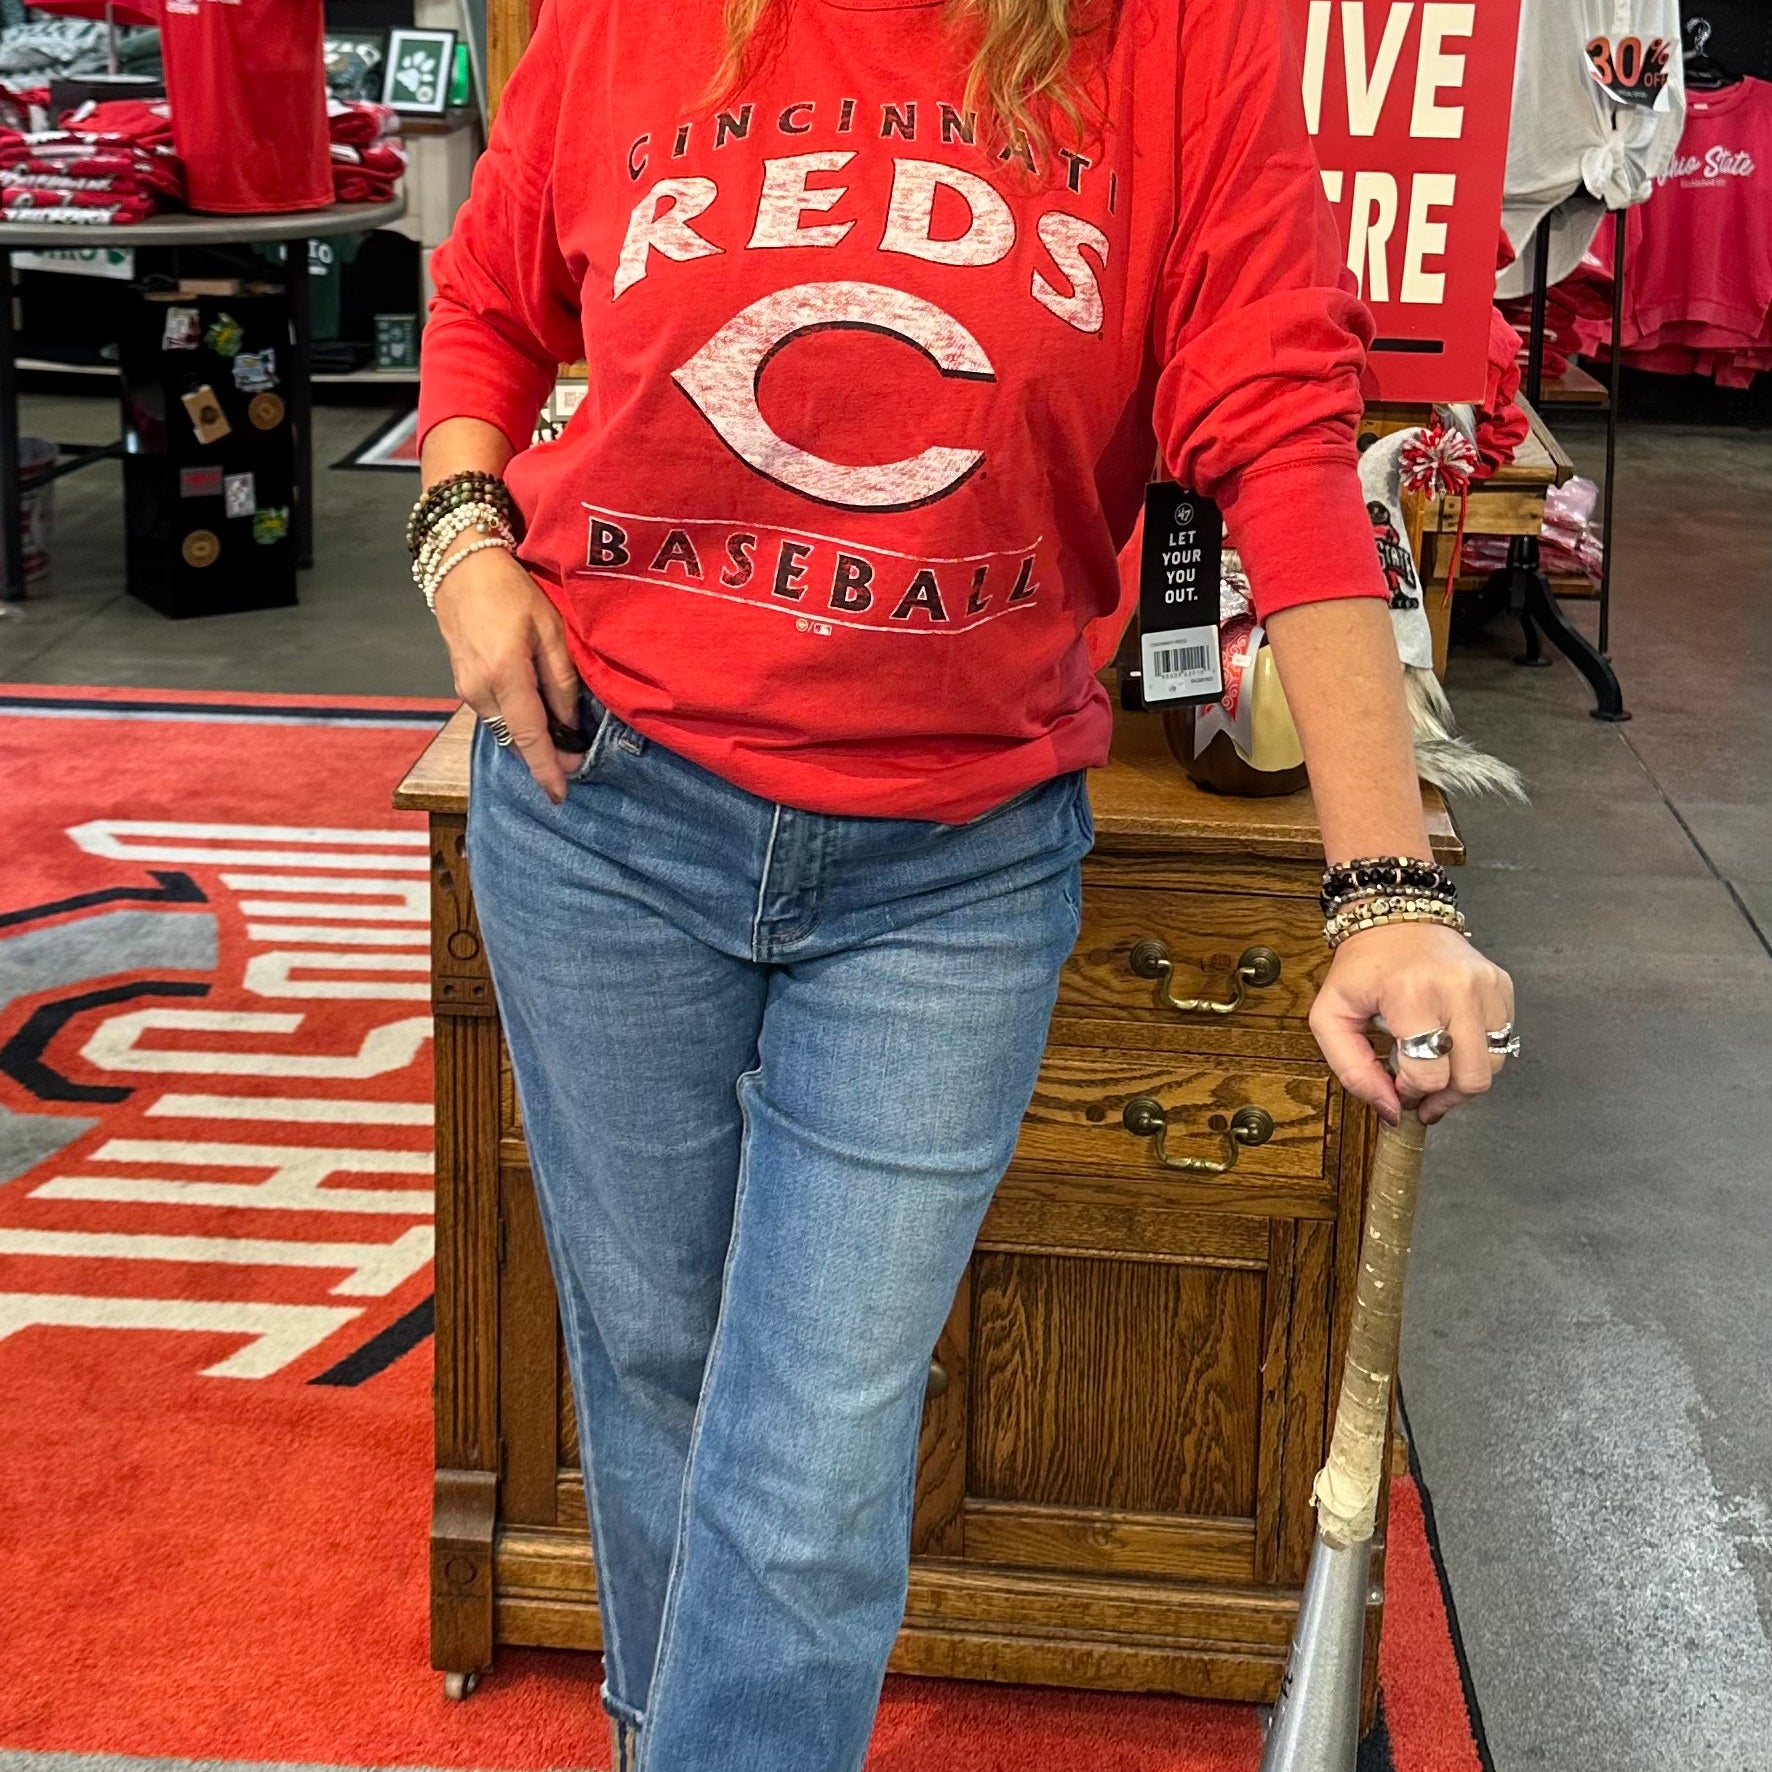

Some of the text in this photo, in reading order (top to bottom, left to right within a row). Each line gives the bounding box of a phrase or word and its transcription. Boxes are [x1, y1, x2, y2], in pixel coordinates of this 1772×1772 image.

[1301, 0, 1476, 139] IVE
[627, 97, 1117, 216] CINCINNATI
[1703, 145, 1755, 179] State
[612, 150, 1110, 334] REDS
[1168, 530, 1197, 547] LET
[587, 515, 1041, 623] BASEBALL
[1162, 548, 1202, 566] YOUR
[1166, 567, 1196, 585] YOU
[1164, 587, 1199, 604] OUT.
